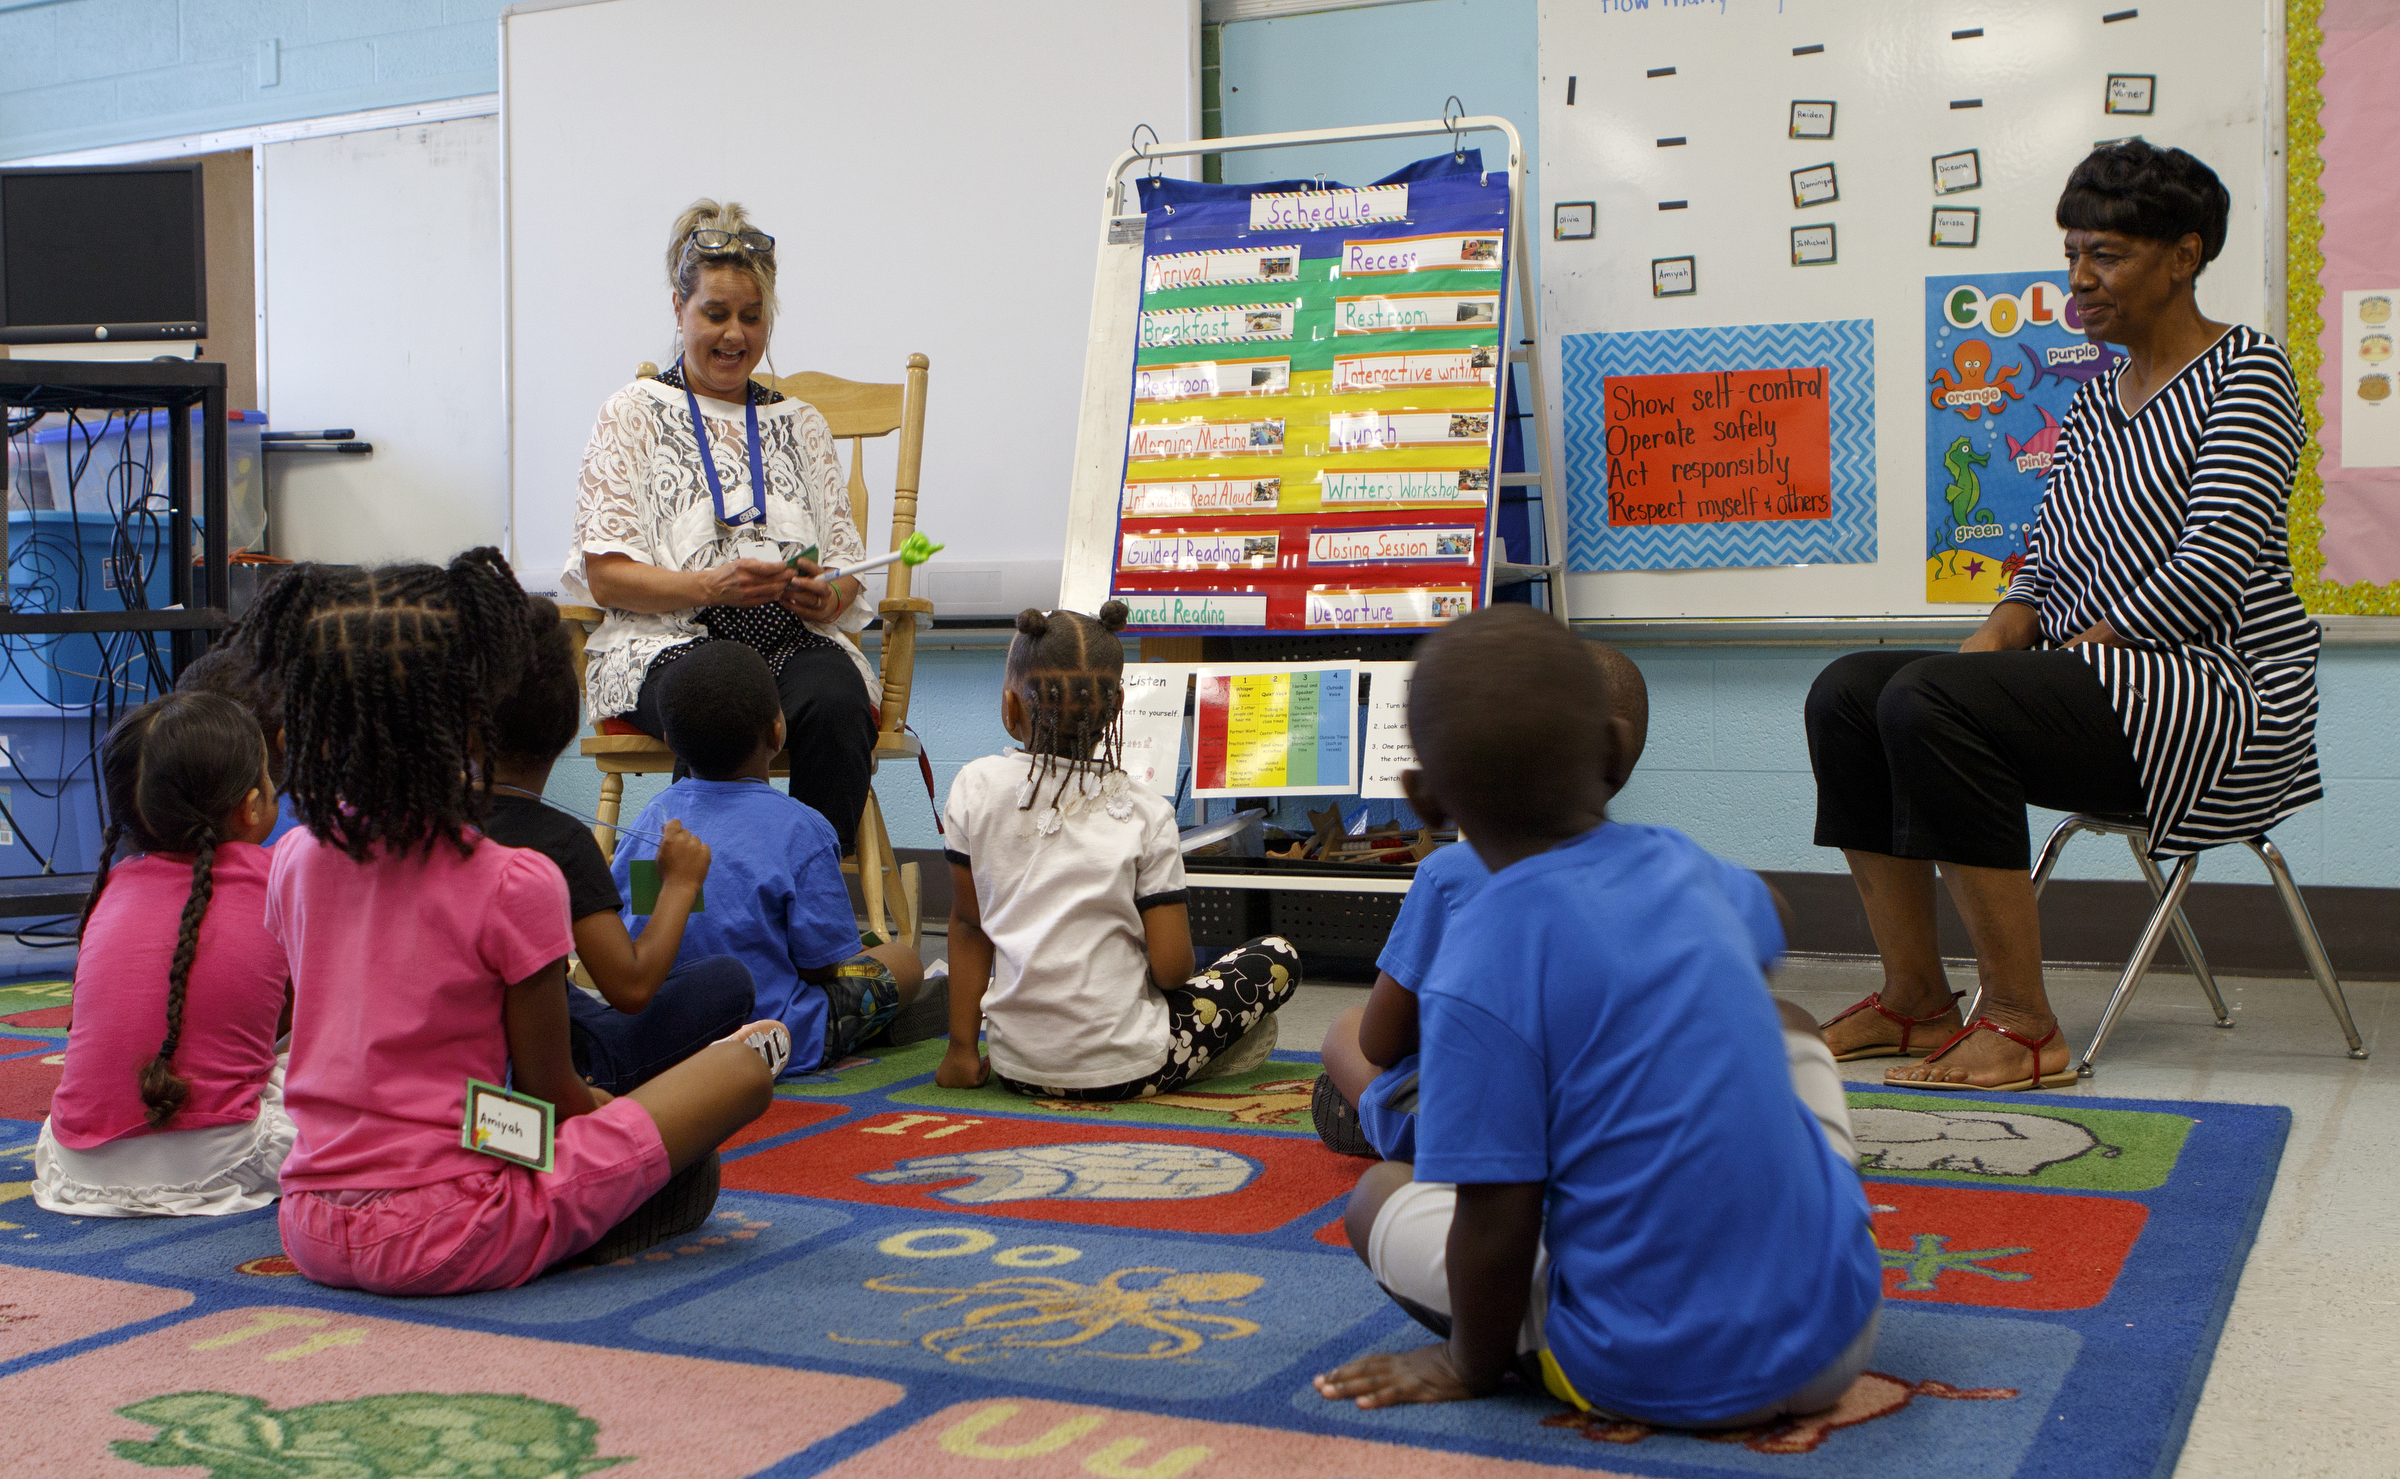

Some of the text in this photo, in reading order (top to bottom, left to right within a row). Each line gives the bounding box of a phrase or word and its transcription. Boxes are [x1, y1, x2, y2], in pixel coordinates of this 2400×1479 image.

[1267, 194, 1370, 224] Schedule
[1560, 214, 1580, 224] Olivia
[1151, 257, 1208, 285] Arrival
[1350, 246, 1417, 271] Recess
[1659, 267, 1689, 280] Amiyah
[1144, 312, 1229, 341] Breakfast
[1346, 301, 1428, 328] Restroom
[2048, 345, 2098, 362] purple
[1142, 369, 1216, 396] Restroom
[1337, 356, 1482, 388] Interactive writing
[1613, 367, 1822, 421] Show self-control
[1947, 388, 1999, 404] orange
[1133, 425, 1246, 455] Morning Meeting
[1338, 415, 1397, 446] Lunch
[1605, 410, 1777, 461] Operate safely
[1608, 447, 1790, 489] Act responsibly
[2018, 453, 2050, 471] pink
[1125, 481, 1253, 509] Interactive Read Aloud
[1326, 472, 1460, 501] Writer's Workshop
[1608, 490, 1687, 525] Respect
[1697, 486, 1760, 523] myself
[1777, 484, 1829, 515] others
[1315, 533, 1428, 560] Closing Session
[1956, 525, 2003, 541] green
[1186, 537, 1240, 564] Reading
[1174, 597, 1225, 626] Reading
[1313, 594, 1394, 625] Departure
[1129, 675, 1166, 687] Listen
[1149, 710, 1180, 718] yourself.
[480, 1112, 523, 1138] Amiyah
